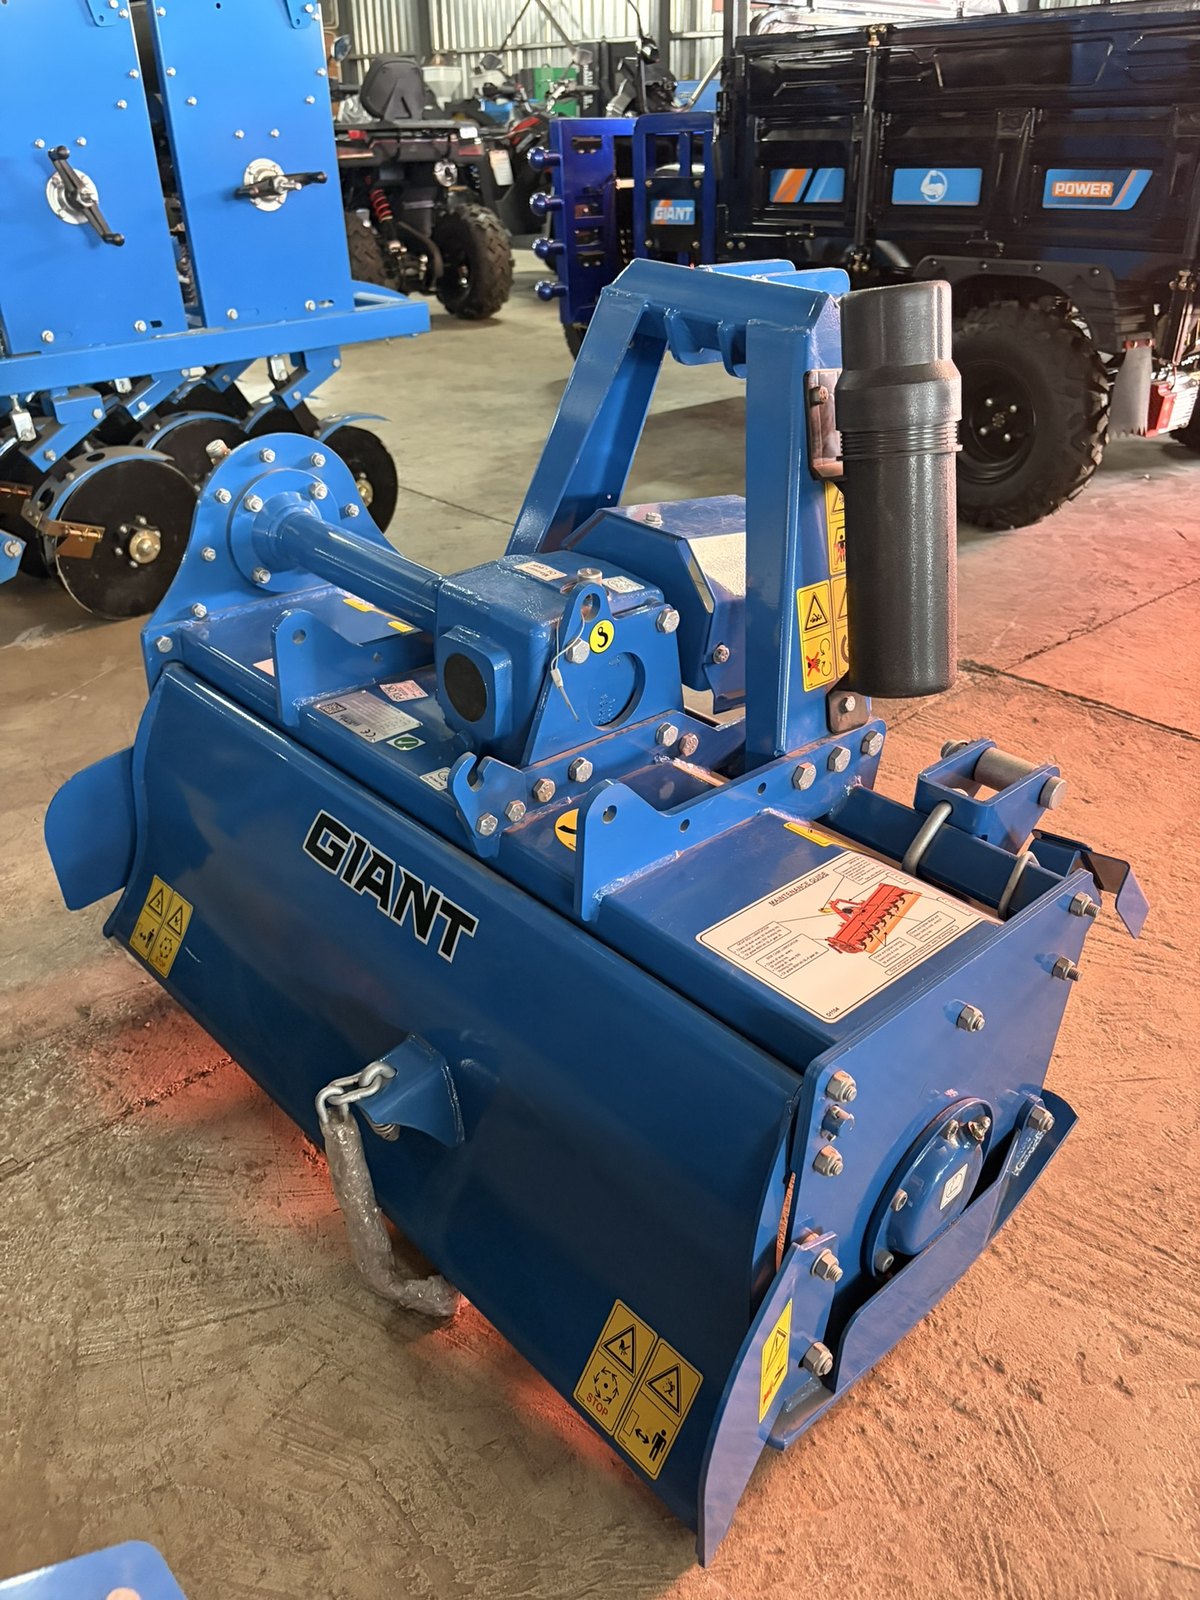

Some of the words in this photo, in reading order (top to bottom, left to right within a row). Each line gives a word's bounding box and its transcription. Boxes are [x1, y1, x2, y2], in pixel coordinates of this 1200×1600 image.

[1055, 182, 1111, 196] POWER
[654, 206, 693, 221] GIANT
[302, 808, 480, 963] GIANT
[768, 880, 809, 906] MAINTENANCE
[586, 1392, 608, 1416] STOP
